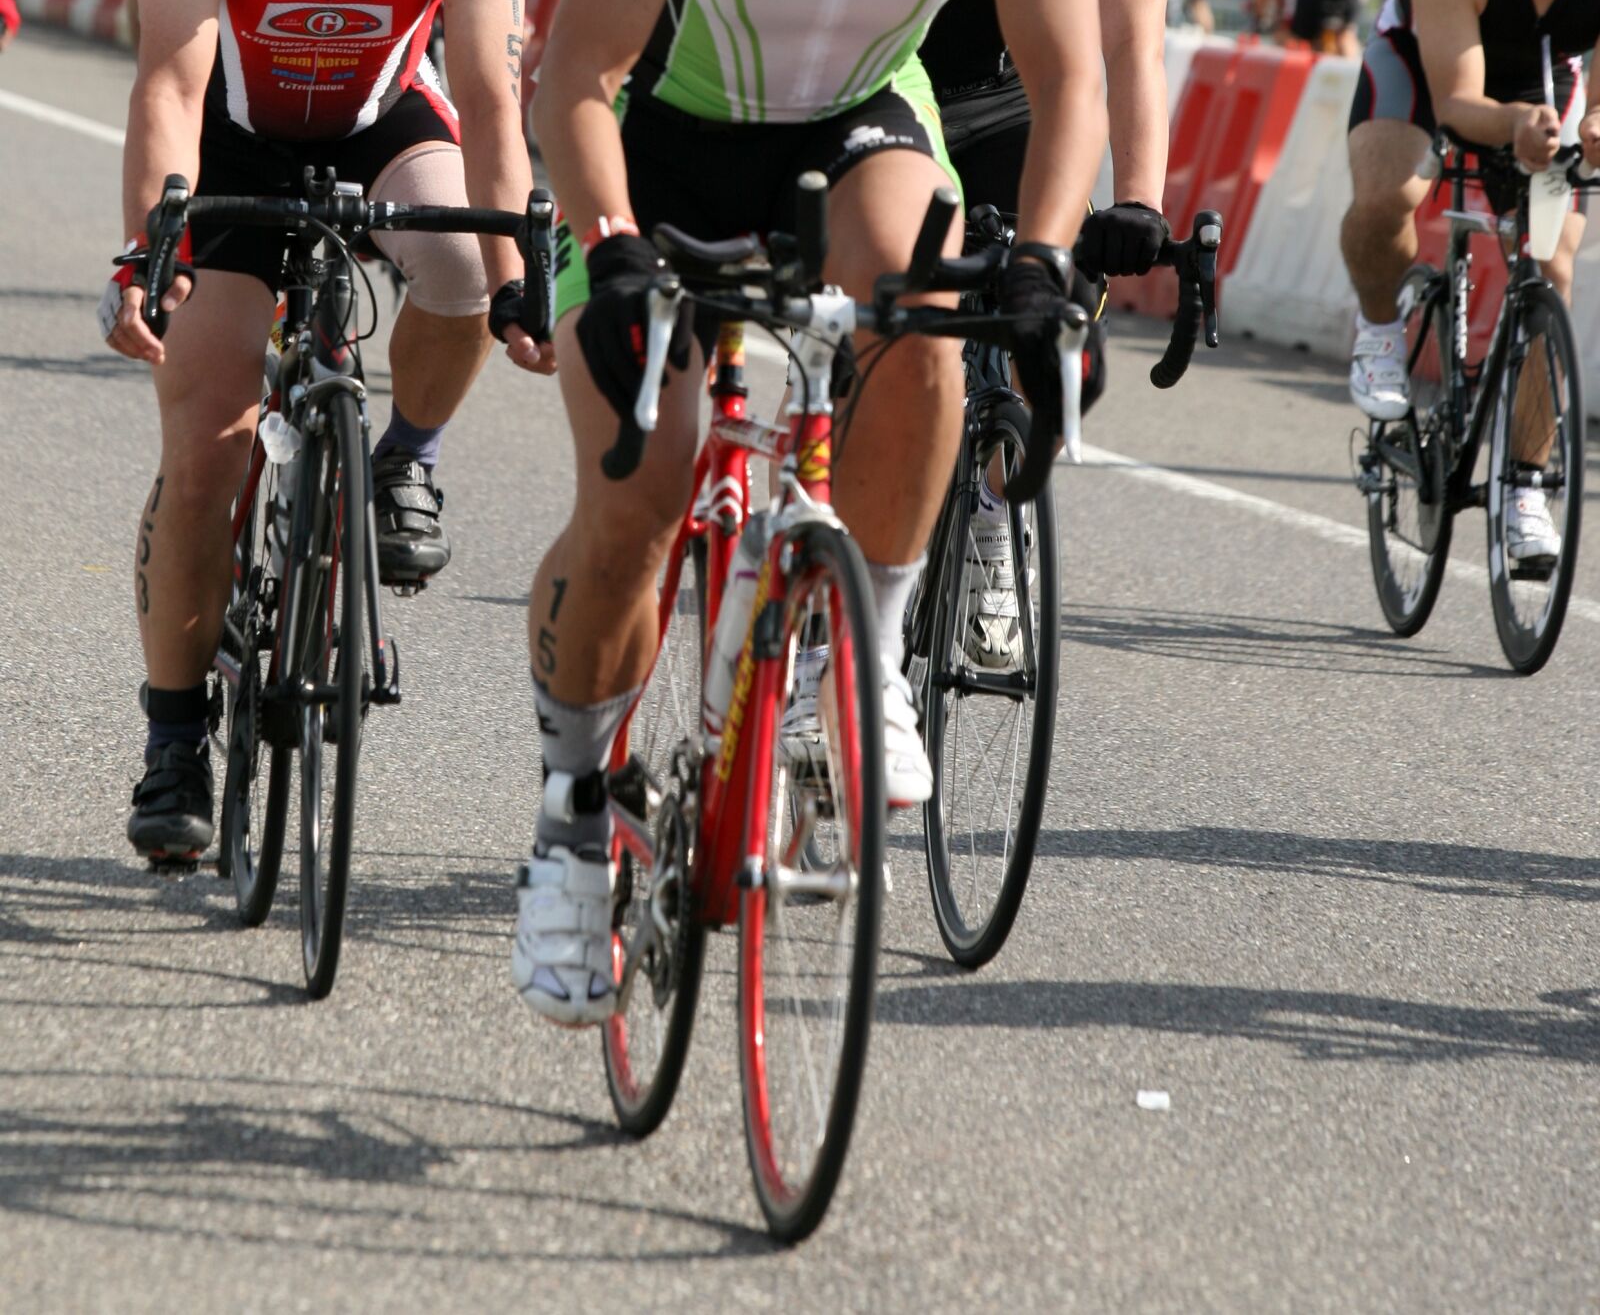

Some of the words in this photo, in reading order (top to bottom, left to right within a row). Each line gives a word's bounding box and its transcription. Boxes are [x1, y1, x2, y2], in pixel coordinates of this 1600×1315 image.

[272, 55, 312, 68] team
[316, 56, 359, 69] korea
[537, 578, 568, 693] 15
